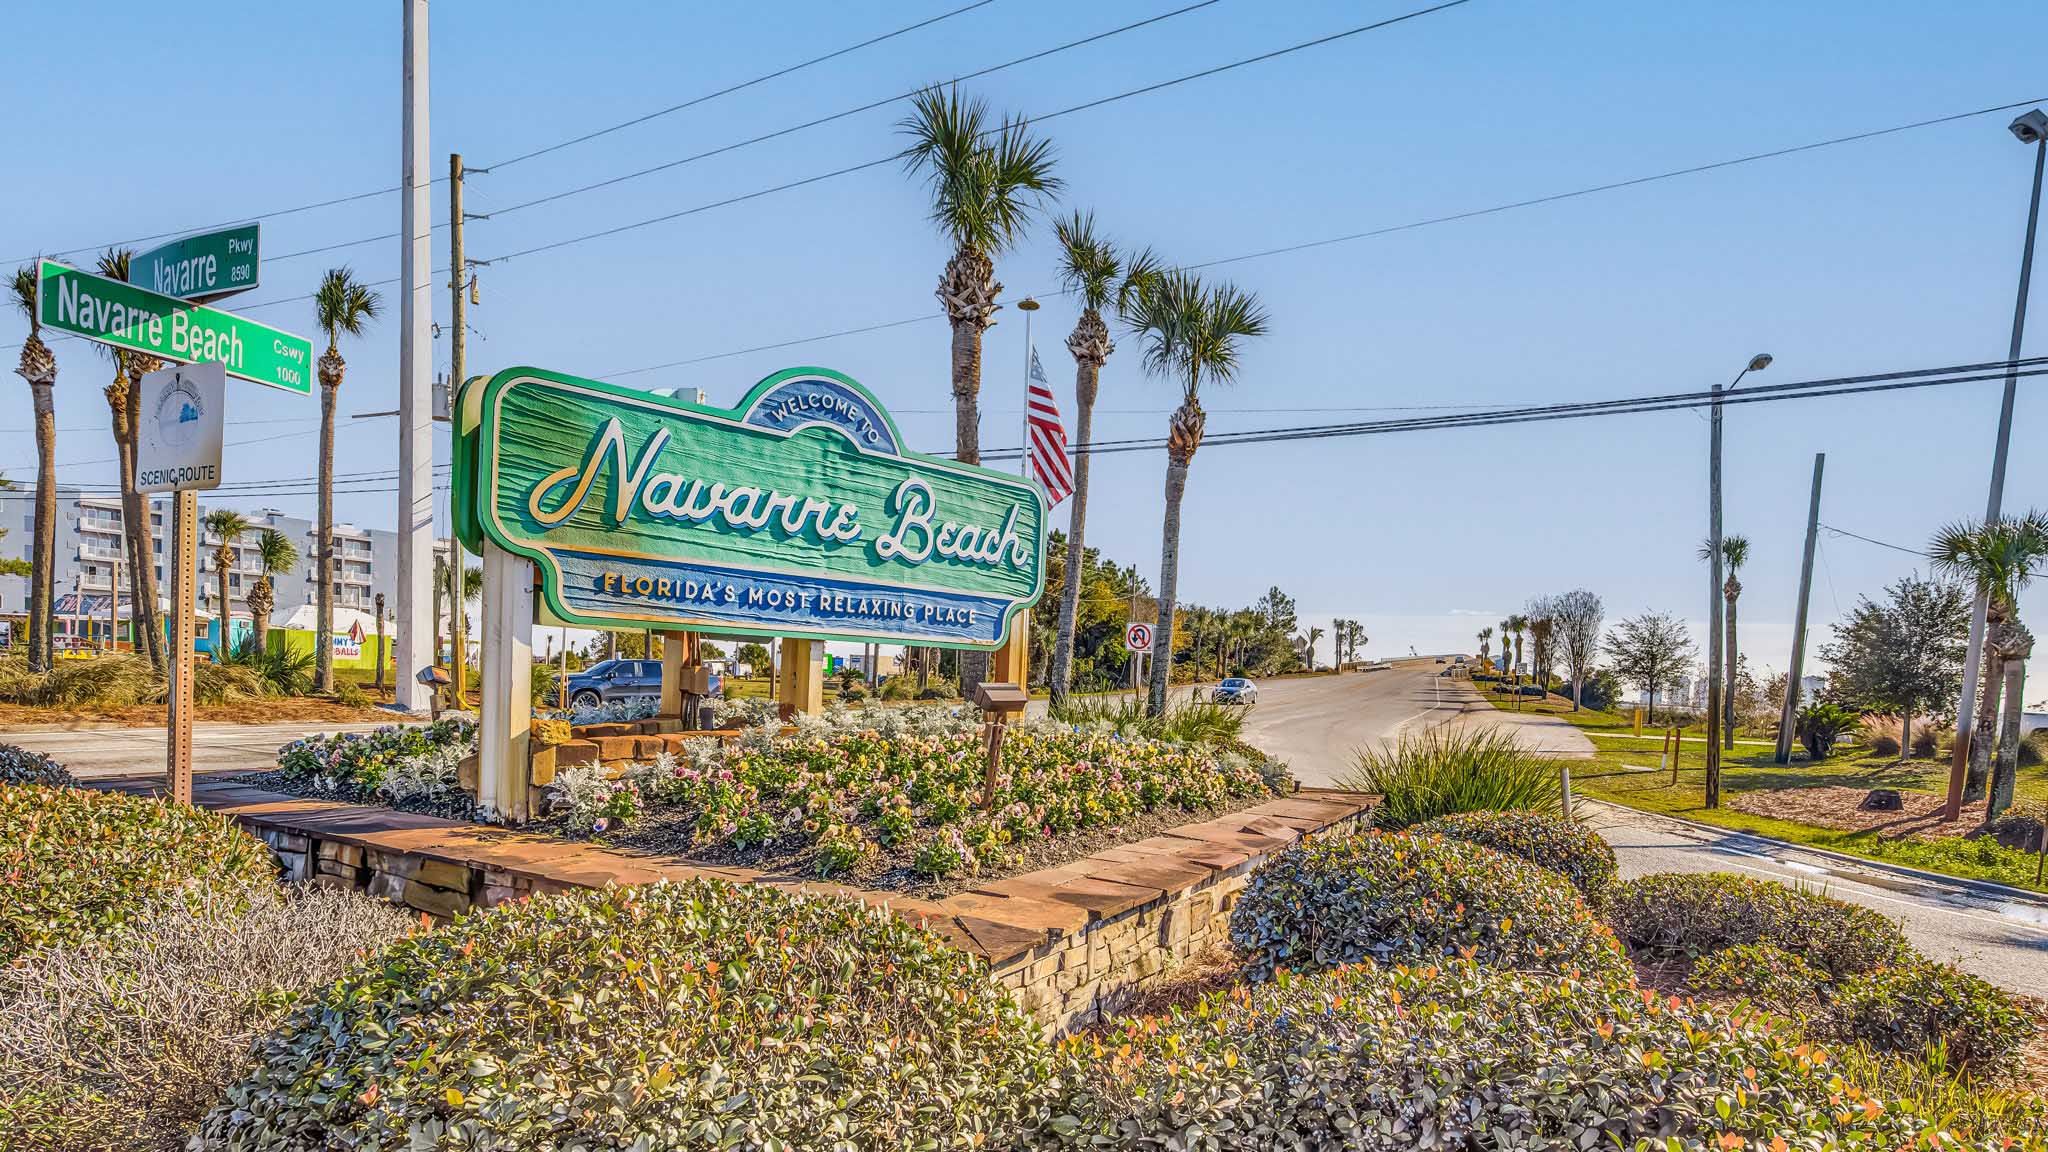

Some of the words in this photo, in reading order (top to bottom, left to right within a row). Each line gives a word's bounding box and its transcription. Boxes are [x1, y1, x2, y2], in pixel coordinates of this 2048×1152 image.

[228, 238, 254, 255] Pkwy
[153, 253, 217, 297] Navarre
[231, 264, 250, 281] 8590
[58, 275, 163, 347] Navarre
[171, 307, 244, 369] Beach
[273, 339, 305, 362] Cswy
[276, 366, 301, 385] 1000
[771, 393, 858, 422] WELCOME
[862, 417, 879, 442] TO
[140, 468, 176, 486] SCENIC
[178, 465, 216, 482] ROUTE
[529, 417, 862, 543] Navarre
[875, 475, 1030, 568] Beach
[604, 575, 735, 602] FLORIDA'S
[748, 587, 810, 608] MOST
[820, 594, 915, 618] RELAXING
[924, 605, 976, 625] PLACE
